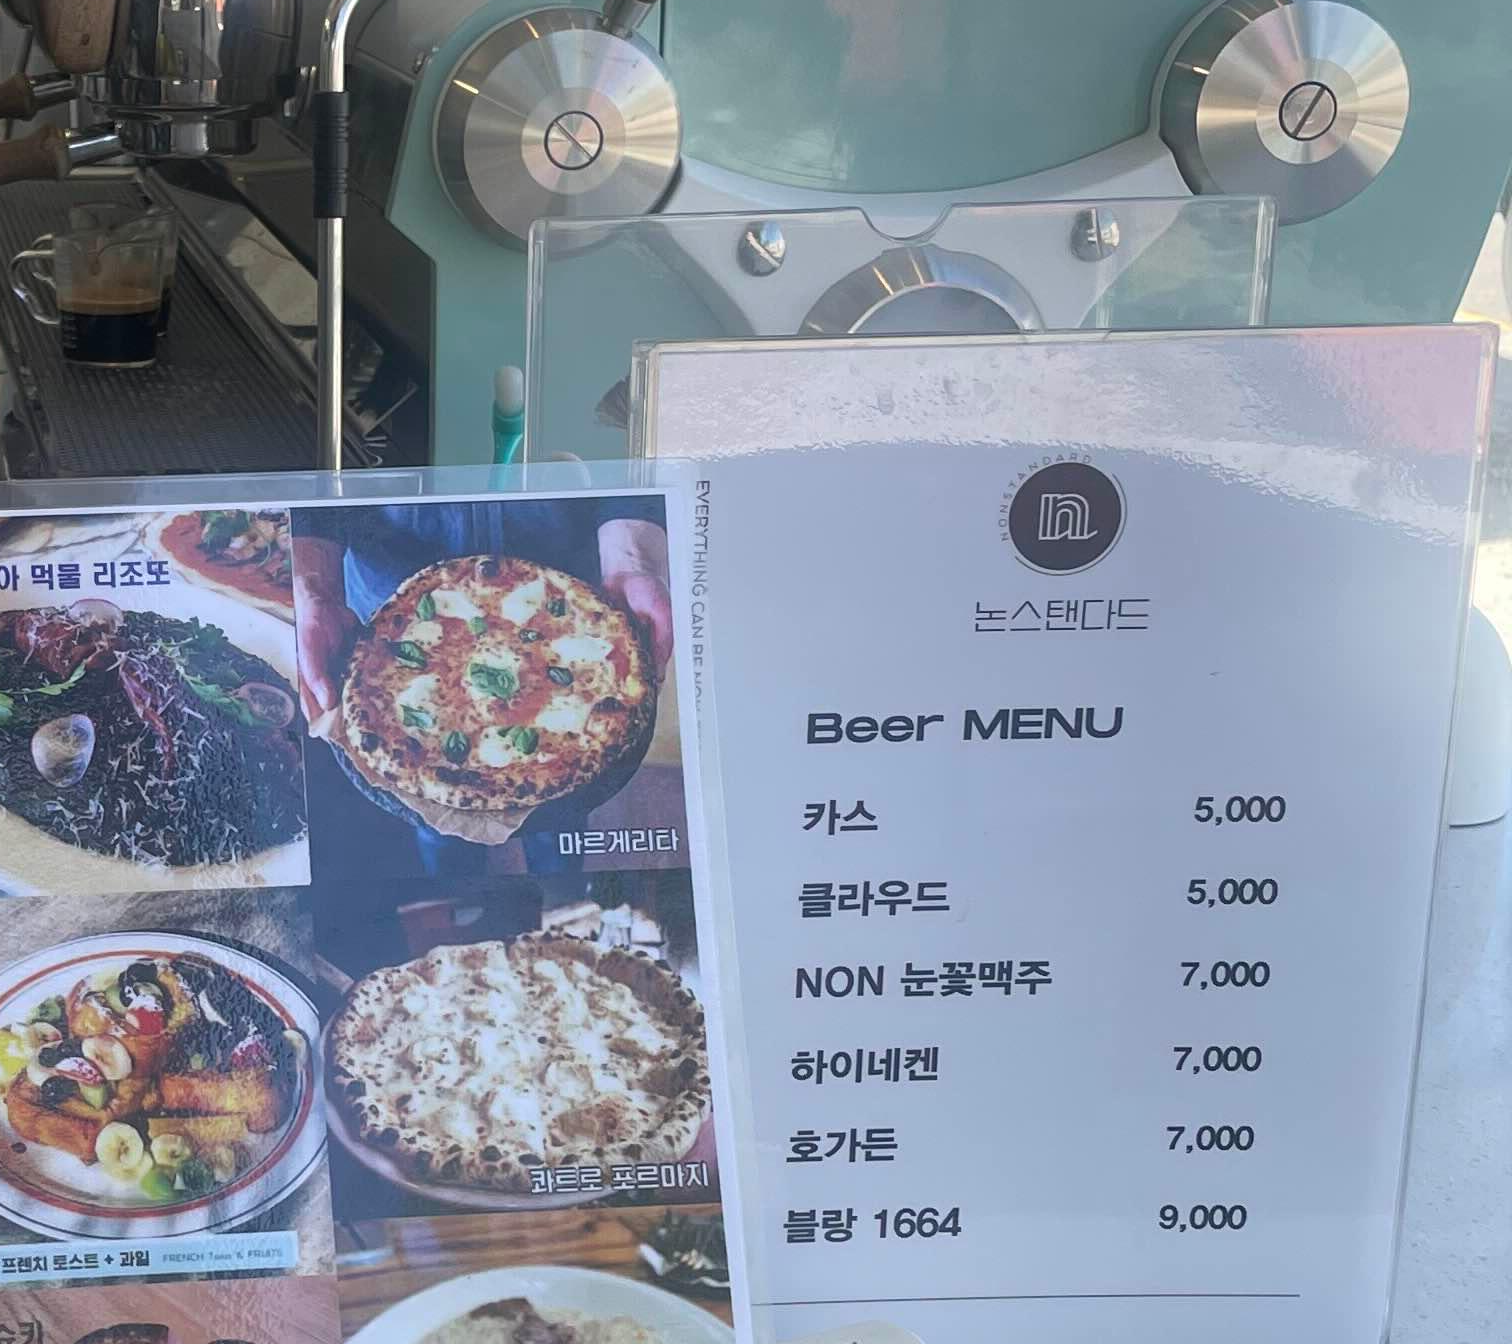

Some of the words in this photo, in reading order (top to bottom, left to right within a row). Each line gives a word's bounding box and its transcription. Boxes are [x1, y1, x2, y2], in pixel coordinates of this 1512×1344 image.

[692, 480, 711, 596] EVERYTHING
[31, 563, 81, 590] 먹물
[93, 560, 171, 587] 리조또
[690, 600, 706, 638] CAN
[975, 598, 1150, 632] 논스탠다드
[806, 712, 944, 744] Beer
[962, 706, 1124, 741] MENU
[802, 799, 879, 836] 카스
[1194, 795, 1286, 826] 5,000
[559, 828, 679, 855] 마르게리타
[798, 880, 950, 918] 클라우드
[1187, 878, 1279, 908] 5,000
[794, 965, 884, 999] NON
[900, 960, 1053, 997] 눈꽃맥주
[1179, 960, 1271, 990] 7,000
[791, 1047, 940, 1084] 하이네켄
[1172, 1046, 1263, 1076] 7,000
[787, 1128, 898, 1164] 호가든
[1165, 1125, 1255, 1154] 7,000
[530, 1167, 603, 1194] 콰트로
[611, 1161, 709, 1191] 포르마지
[783, 1208, 857, 1243] 블랑
[874, 1208, 962, 1239] 1664
[1158, 1205, 1248, 1235] 9,000
[1, 1257, 48, 1274] 프렌치
[53, 1254, 99, 1271] 토스트
[119, 1250, 150, 1267] 과일
